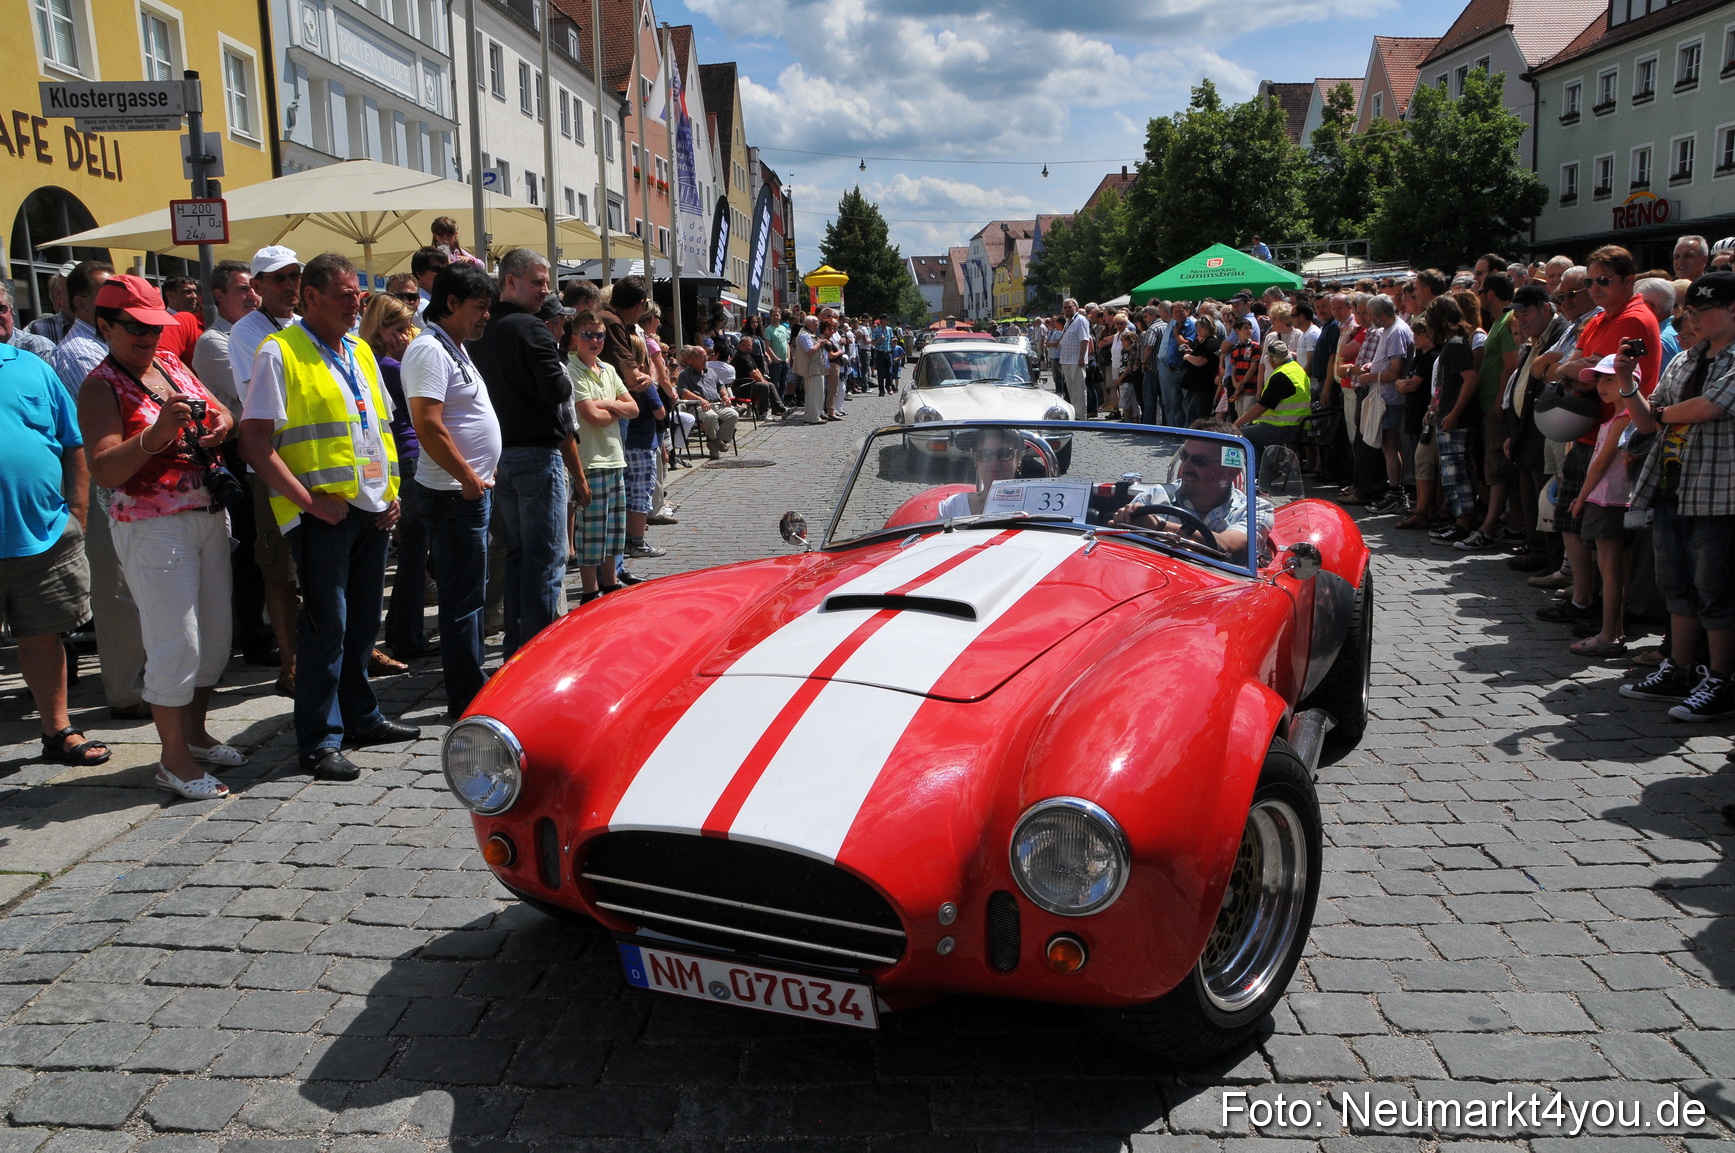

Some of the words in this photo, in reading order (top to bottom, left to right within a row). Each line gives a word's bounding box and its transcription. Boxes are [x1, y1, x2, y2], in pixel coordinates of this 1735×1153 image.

[378, 50, 411, 87] WEBER
[49, 87, 168, 113] Klostergasse
[64, 125, 123, 182] DELI
[177, 204, 184, 214] H
[191, 203, 212, 214] 200
[1612, 198, 1670, 230] RENO
[684, 244, 707, 257] 2012
[713, 214, 729, 277] HULE
[751, 204, 771, 290] THULE
[785, 239, 797, 292] HOTEL
[1179, 270, 1245, 280] Lammsbräu
[1038, 492, 1065, 512] 33
[631, 968, 641, 980] D
[648, 952, 705, 994] NM
[729, 967, 864, 1021] 07034
[1238, 972, 1258, 989] BBS
